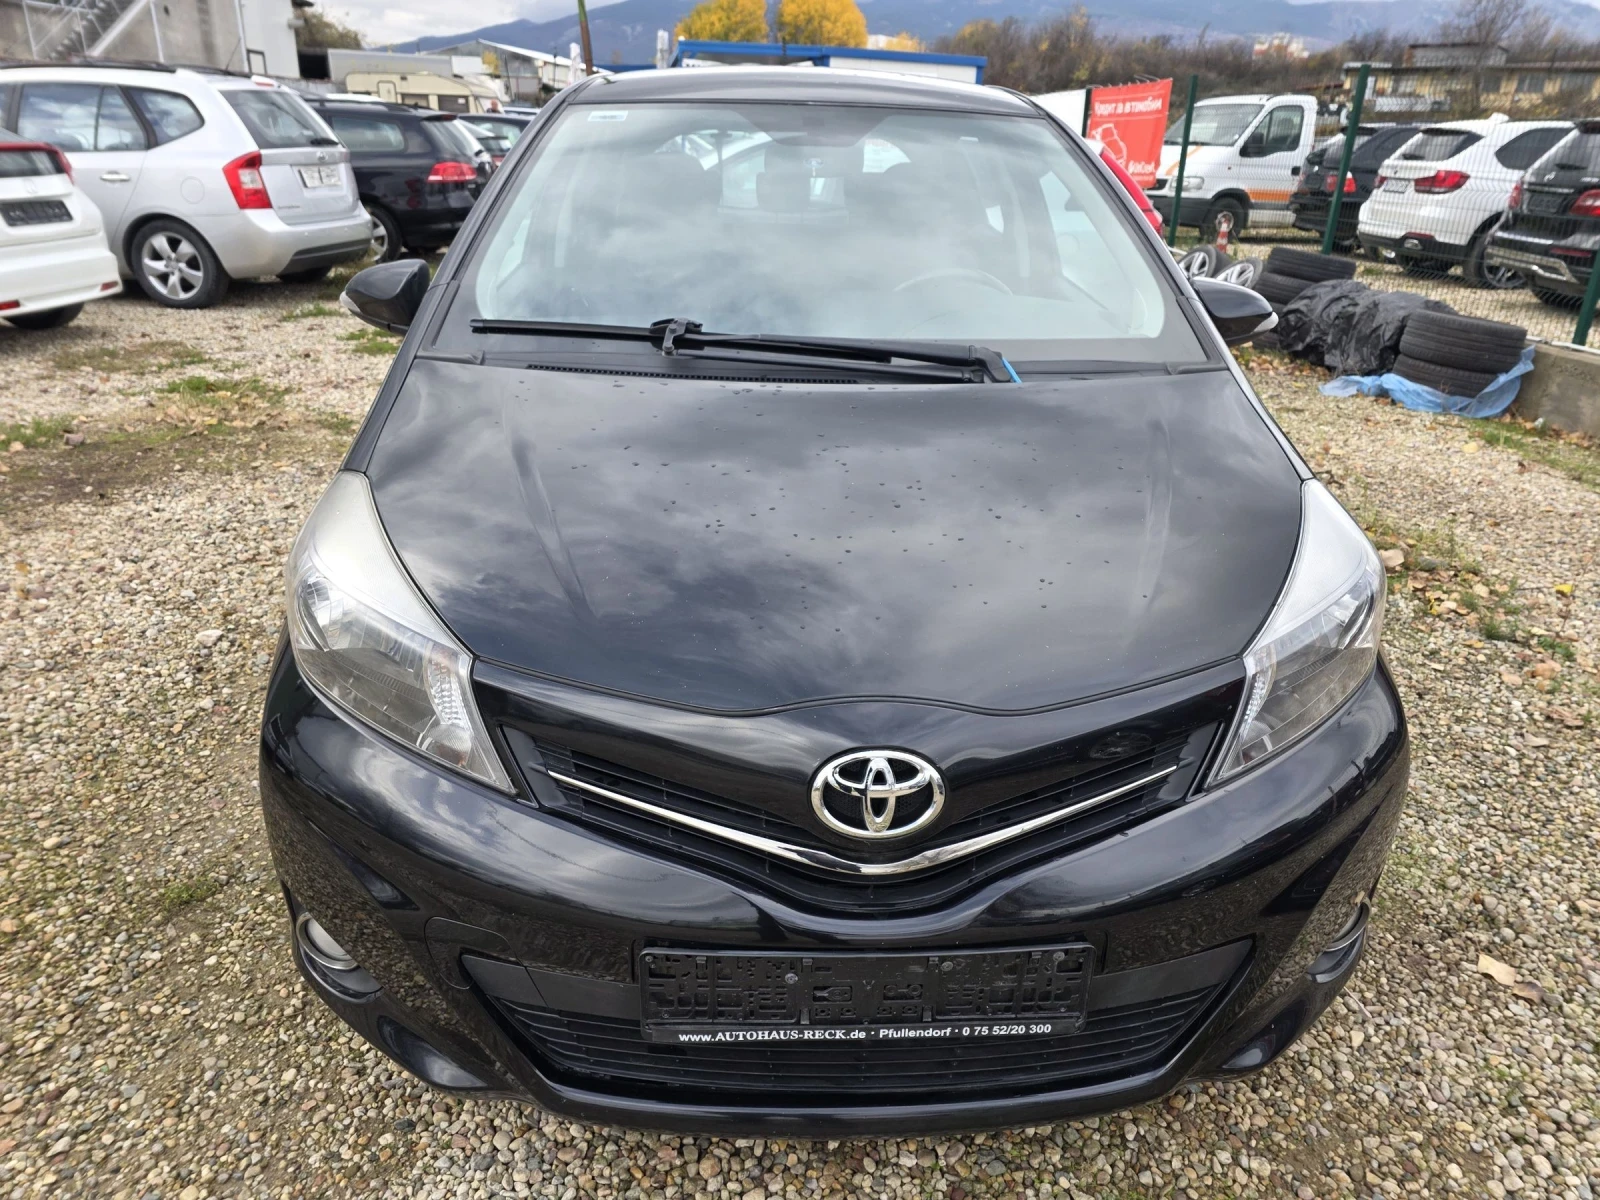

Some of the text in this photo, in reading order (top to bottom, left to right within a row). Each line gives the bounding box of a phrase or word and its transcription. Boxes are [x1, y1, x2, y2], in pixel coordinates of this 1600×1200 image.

[678, 1024, 1052, 1042] www.AUTOHAUS-RECK.de Pfullendorf 0 75 52/20 300
